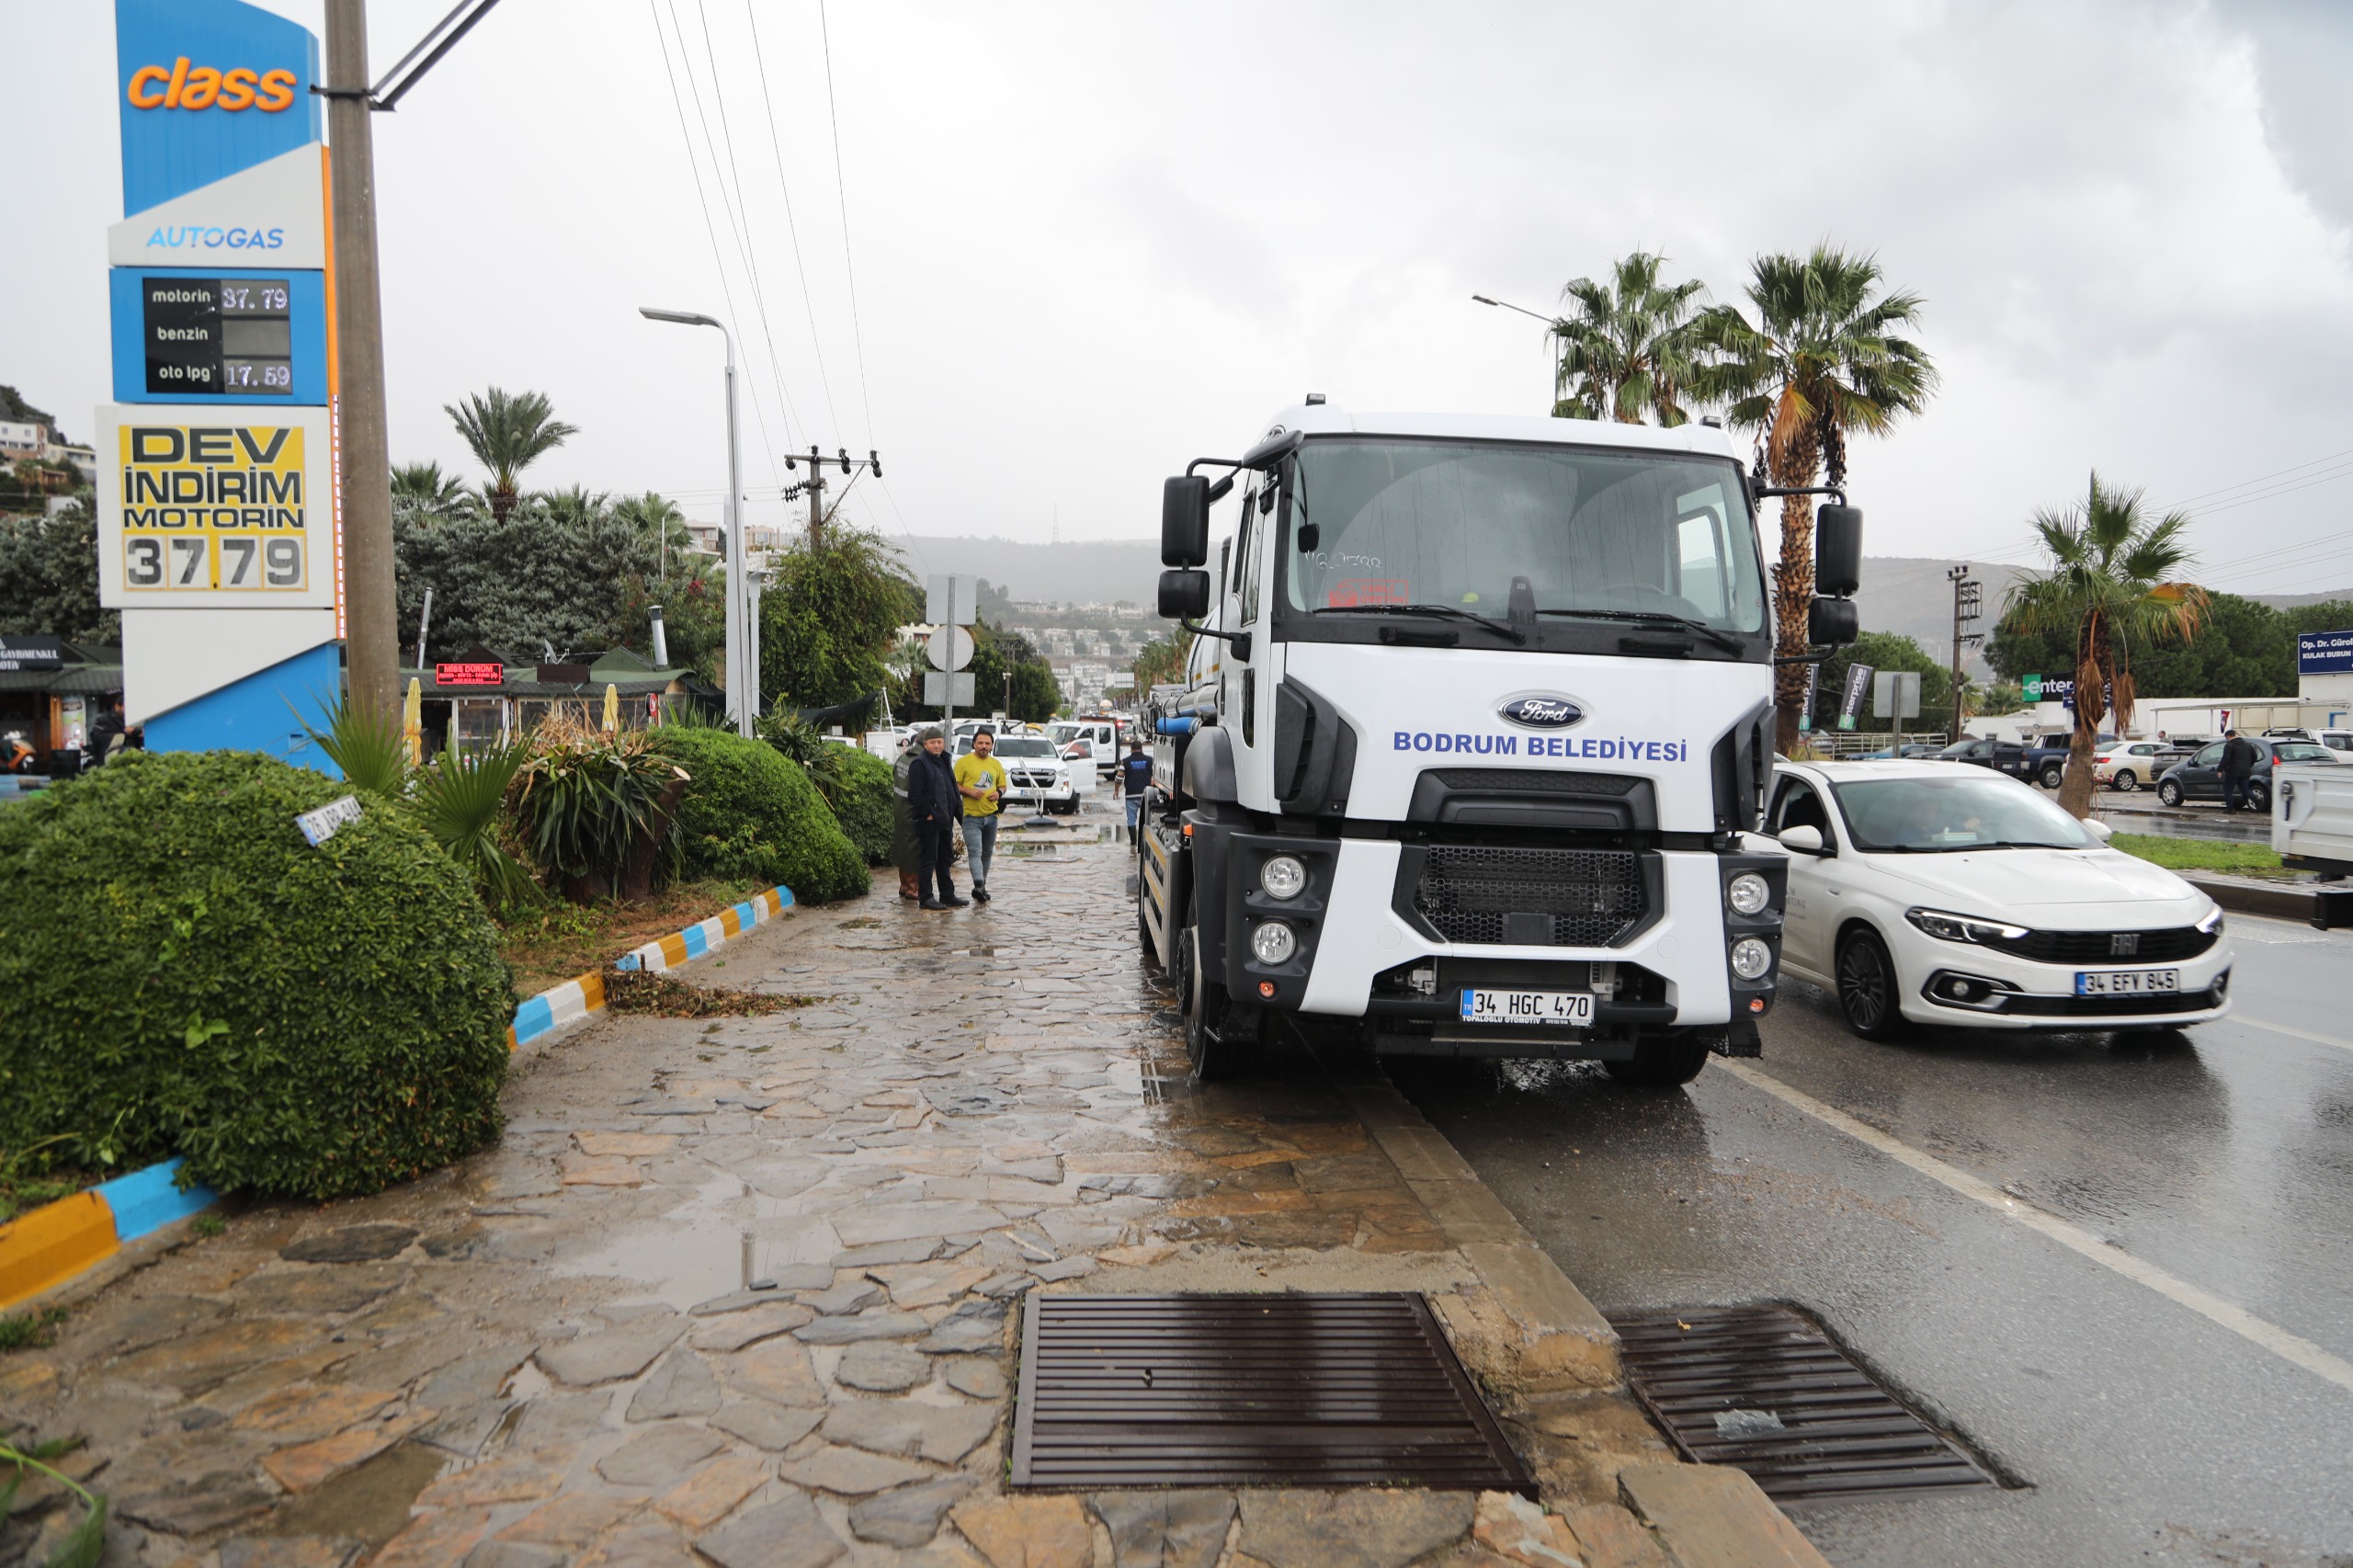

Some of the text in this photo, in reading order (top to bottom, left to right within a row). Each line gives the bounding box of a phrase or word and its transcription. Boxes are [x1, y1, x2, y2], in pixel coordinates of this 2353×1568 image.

[128, 56, 297, 112] class
[145, 226, 284, 249] AUTOGAS
[152, 288, 288, 310] motorin 37.79
[157, 326, 208, 340] benzin
[159, 367, 184, 380] oto
[187, 366, 210, 382] lpg
[131, 427, 291, 463] DEV
[125, 466, 301, 505] İNDİRİM
[124, 505, 304, 528] MOTORİN
[2301, 641, 2315, 650] Op.
[1843, 667, 1863, 728] enterprise
[1519, 699, 1569, 722] Ford
[1393, 732, 1688, 763] BODRUM BELEDİYESİ
[2109, 934, 2141, 956] FIAT
[2086, 971, 2174, 992] 34 EFY 845
[1474, 993, 1496, 1014] 34
[1508, 994, 1543, 1016] HGC
[1554, 995, 1589, 1017] 470
